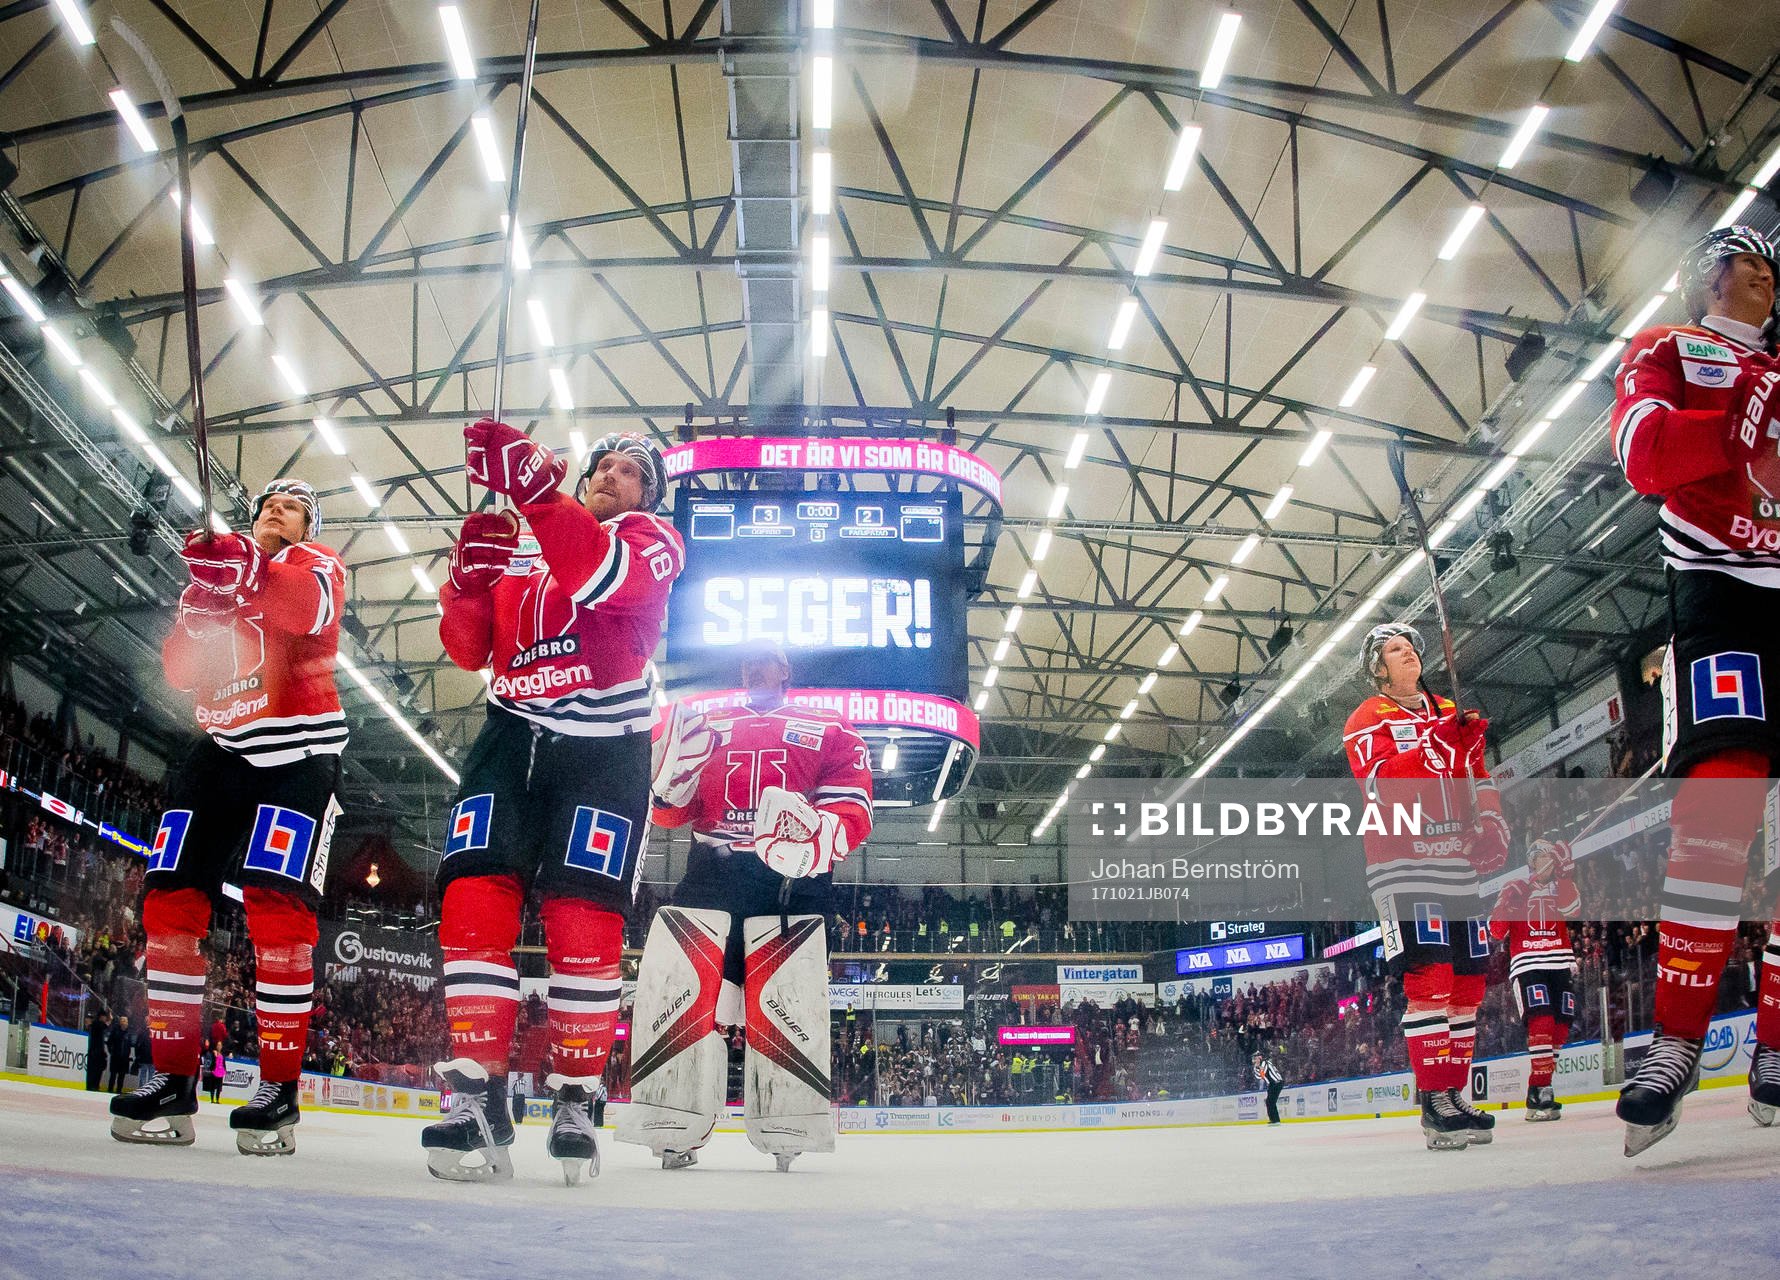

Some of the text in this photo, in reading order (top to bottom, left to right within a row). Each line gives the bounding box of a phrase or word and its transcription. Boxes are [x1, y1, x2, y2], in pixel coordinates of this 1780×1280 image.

[664, 449, 694, 474] RO!
[761, 444, 801, 466] DET
[806, 442, 834, 466] ÄR
[840, 446, 860, 467] VI
[865, 446, 912, 468] SOM
[917, 444, 944, 471] ÄR
[763, 509, 773, 522] 3
[807, 506, 833, 517] 0:00
[862, 510, 873, 523] 2
[640, 540, 674, 582] 18
[702, 576, 932, 648] SEGER!
[512, 638, 577, 668] ÖREBRO
[849, 693, 879, 721] ÄR
[884, 693, 958, 732] ÖREBRO
[785, 731, 820, 748] ELON
[1354, 733, 1374, 768] 17
[1228, 921, 1266, 935] Strateg
[334, 931, 433, 969] Gustavsvik
[1188, 942, 1291, 969] NA NA NA
[1063, 967, 1138, 982] Vintergatan
[866, 991, 912, 999] HERCULES
[915, 986, 942, 997] Let's
[652, 988, 692, 1033] BAUER
[766, 998, 810, 1044] BAUER
